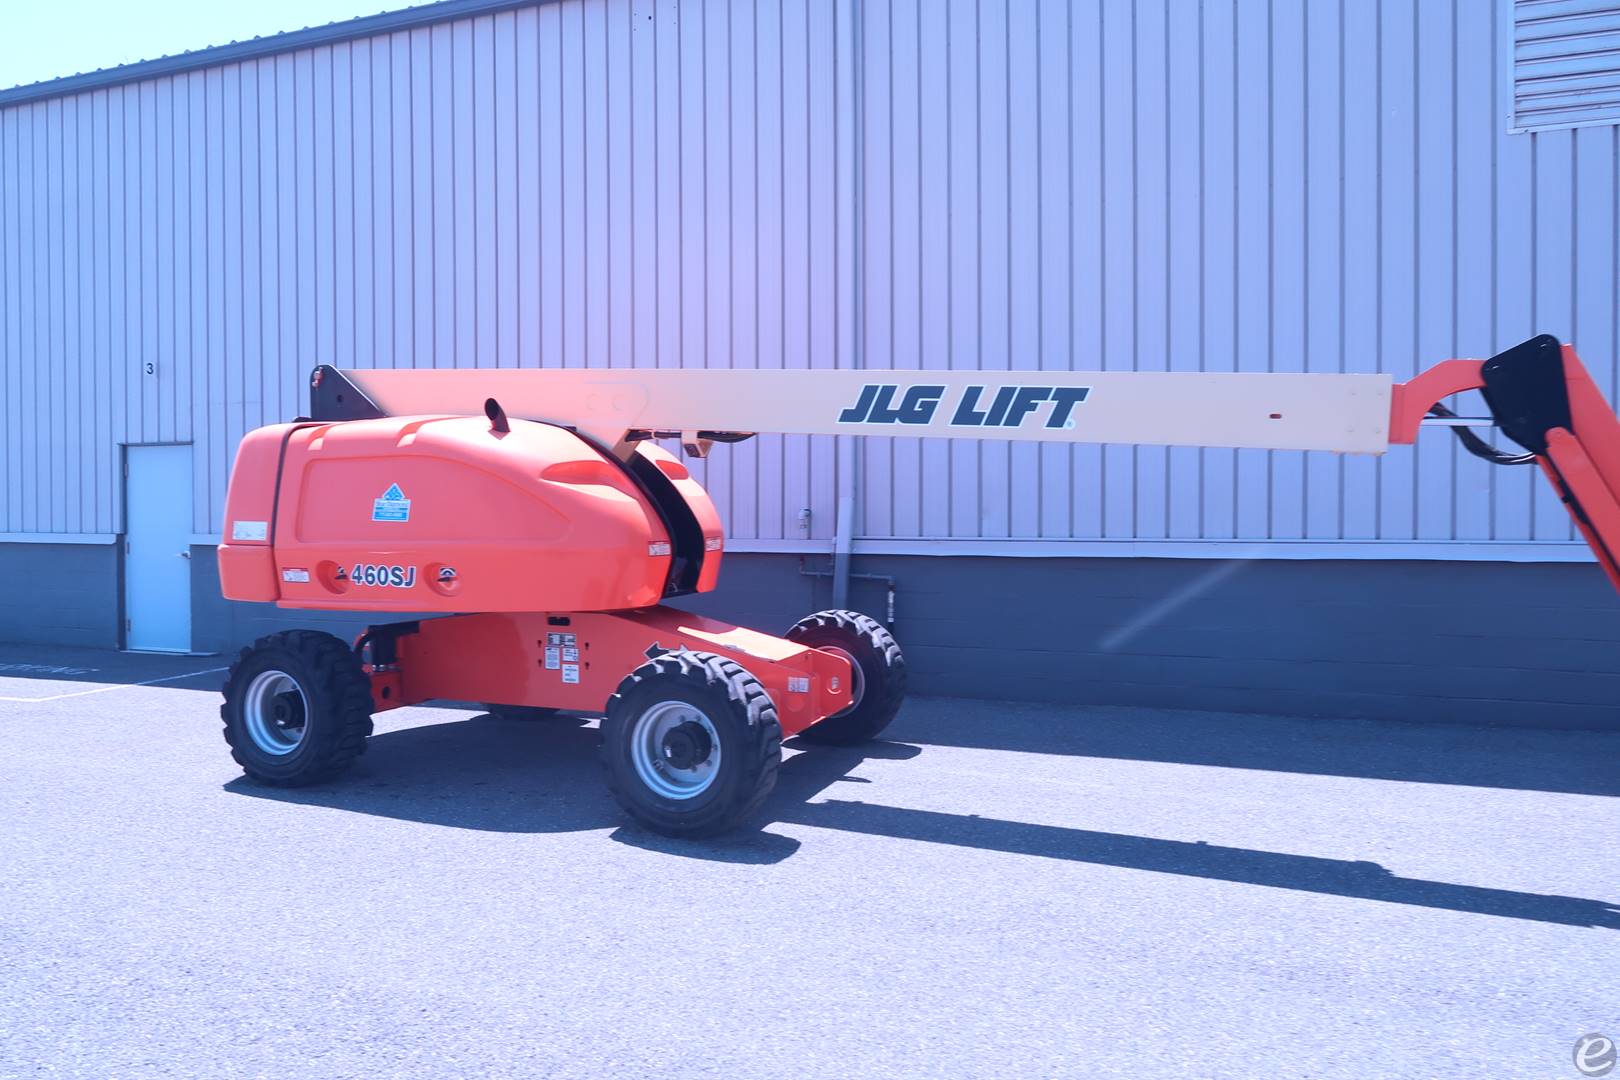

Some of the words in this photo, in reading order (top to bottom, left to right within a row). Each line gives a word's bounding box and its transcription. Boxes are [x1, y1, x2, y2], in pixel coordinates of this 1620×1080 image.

[146, 362, 154, 375] 3
[838, 385, 946, 425] JLG
[950, 386, 1091, 428] LIFT
[351, 564, 416, 588] 460SJ
